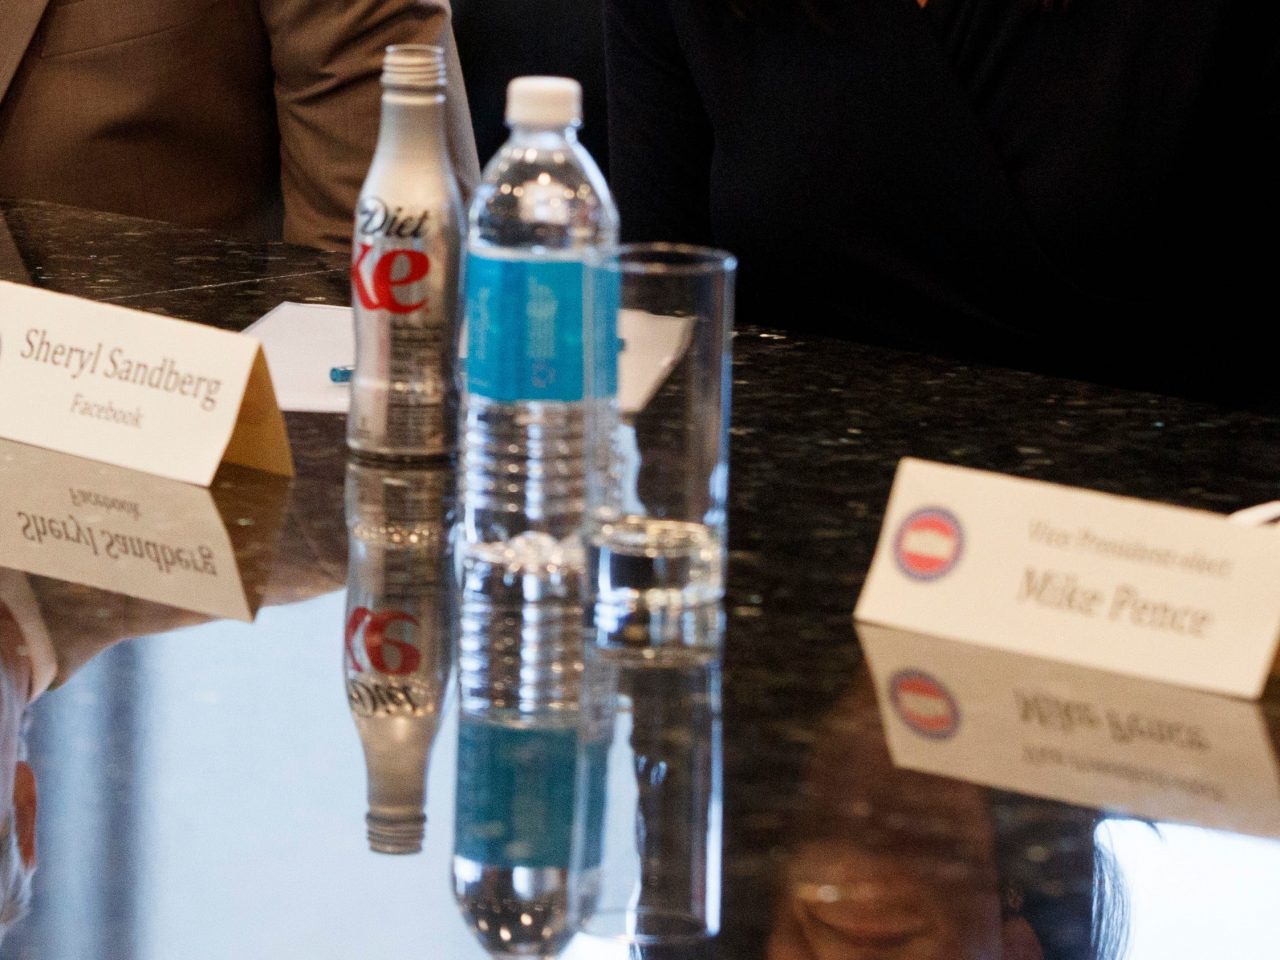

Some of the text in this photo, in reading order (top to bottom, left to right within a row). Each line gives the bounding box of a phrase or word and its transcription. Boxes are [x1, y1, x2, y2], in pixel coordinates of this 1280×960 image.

[357, 196, 431, 240] Diet
[19, 327, 102, 381] Sheryl
[104, 343, 223, 410] Sandberg
[69, 393, 143, 429] Facebook
[1016, 563, 1214, 640] Mike Pence
